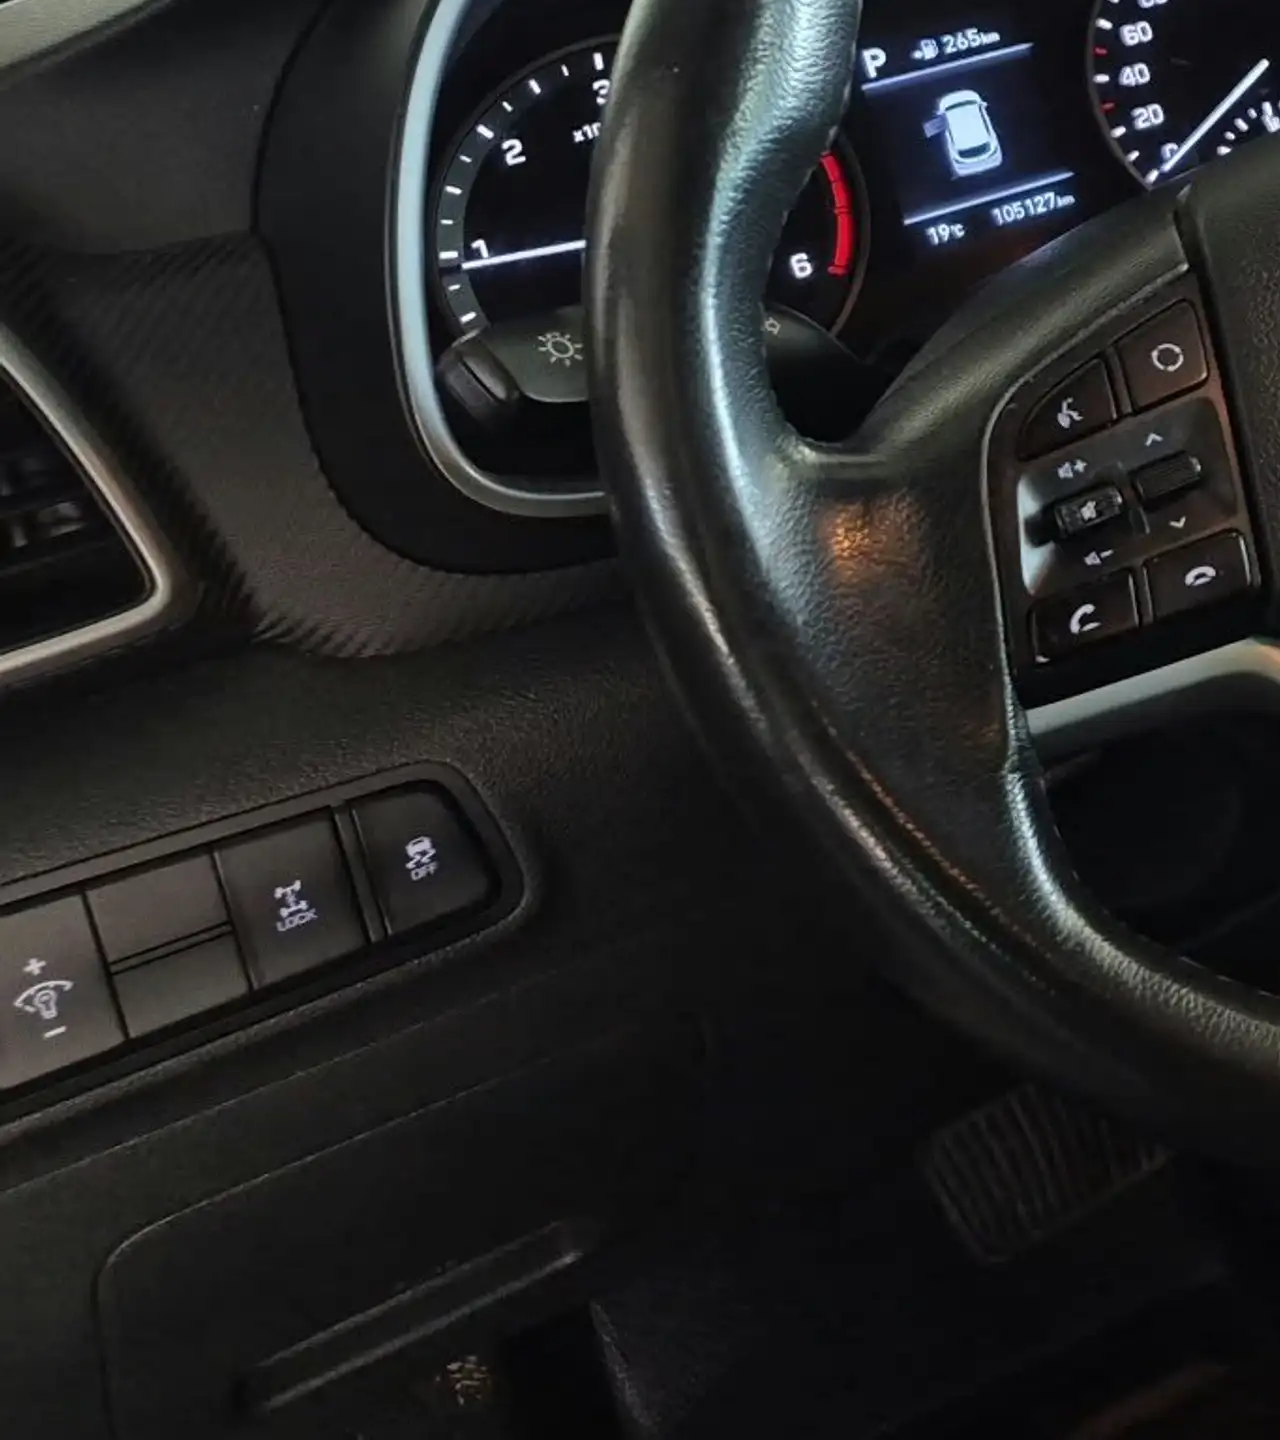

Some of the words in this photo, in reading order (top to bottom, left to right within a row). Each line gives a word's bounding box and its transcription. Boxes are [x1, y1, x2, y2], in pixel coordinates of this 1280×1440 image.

[1119, 21, 1153, 46] 60
[862, 48, 887, 78] P
[1119, 62, 1151, 86] 40
[1131, 103, 1164, 130] 20
[501, 139, 526, 166] 2
[789, 252, 813, 279] 6
[411, 861, 438, 881] OFF
[276, 908, 318, 932] LOCK
